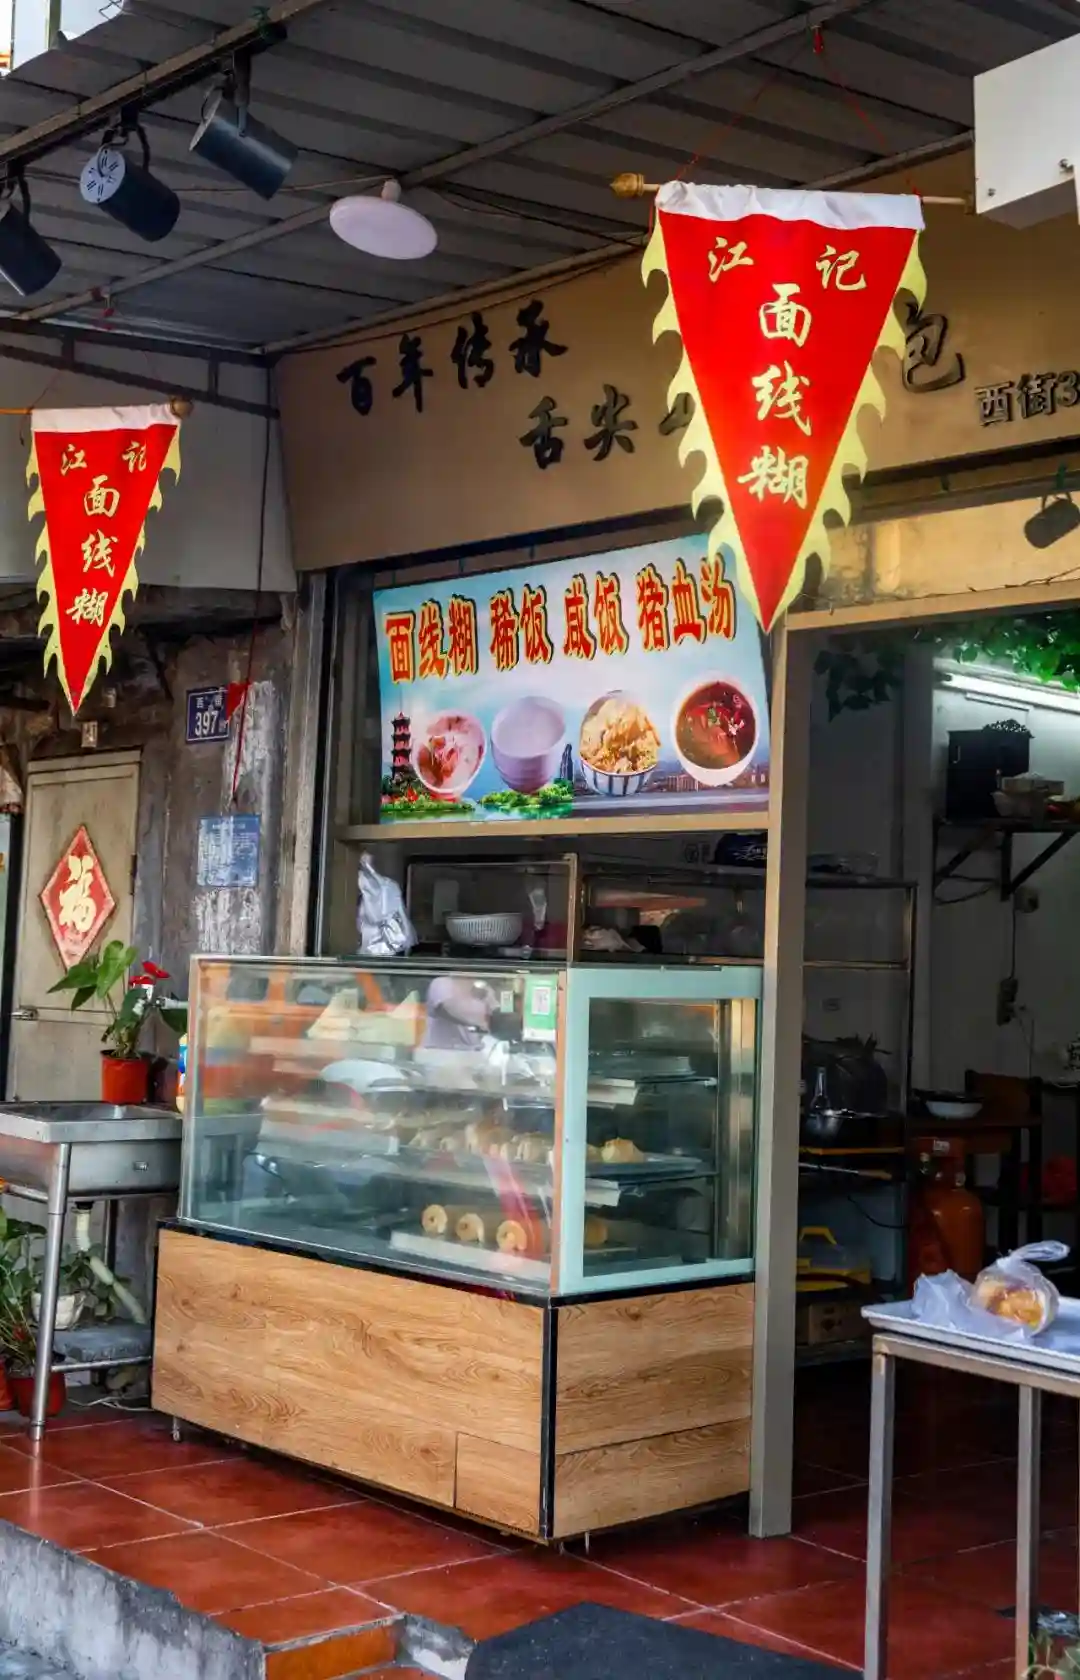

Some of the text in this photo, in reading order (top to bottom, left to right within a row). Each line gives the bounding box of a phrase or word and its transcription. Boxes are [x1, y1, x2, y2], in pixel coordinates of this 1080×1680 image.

[708, 237, 867, 291] 江记
[336, 300, 568, 416] 百年传承
[738, 283, 813, 509] 面线糊
[60, 440, 147, 477] 江记
[66, 474, 120, 627] 面线糊
[384, 551, 737, 684] 面线糊 稀饭 咸饭 猪血汤
[59, 855, 97, 932] 福
